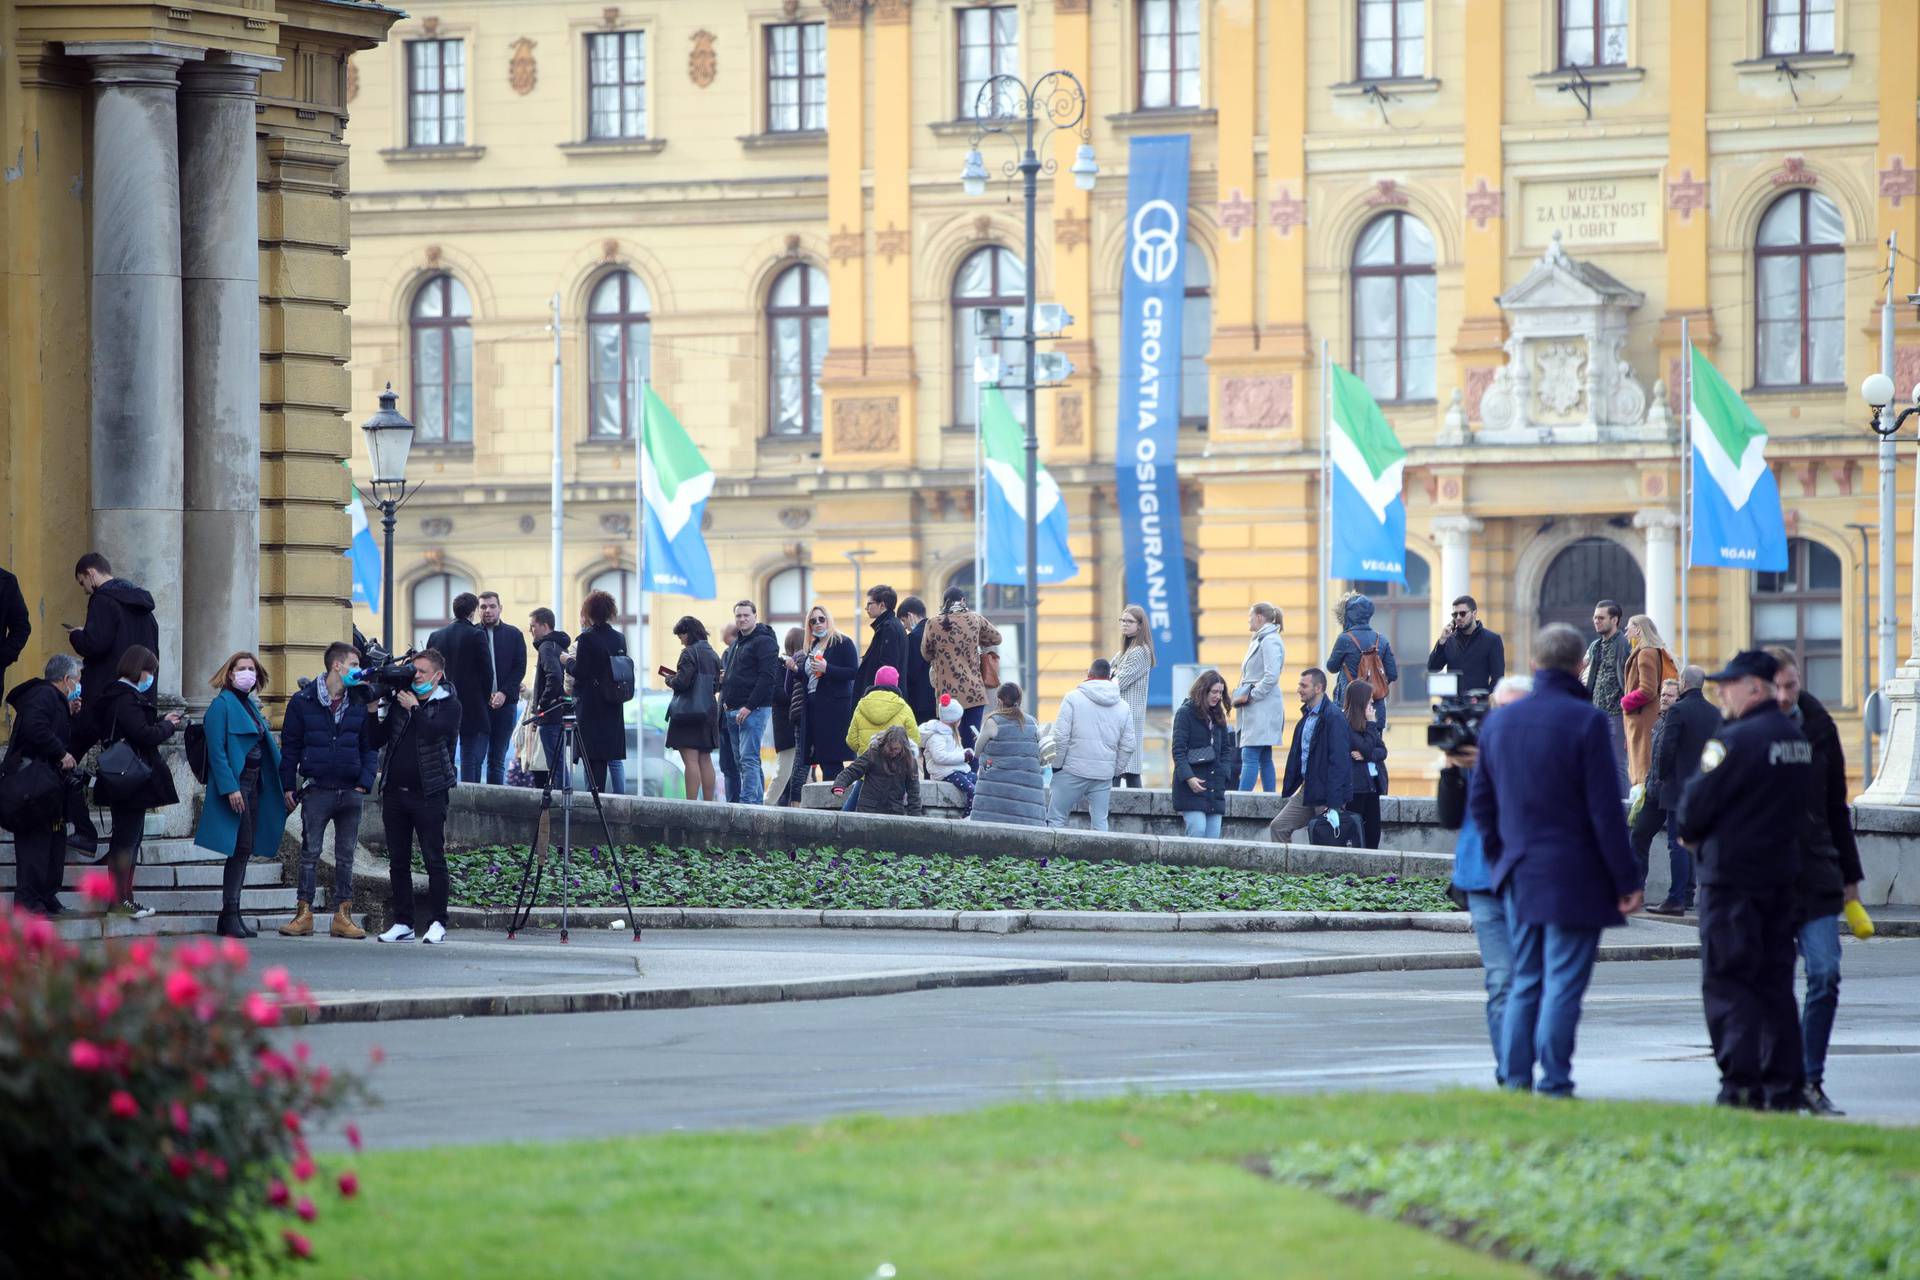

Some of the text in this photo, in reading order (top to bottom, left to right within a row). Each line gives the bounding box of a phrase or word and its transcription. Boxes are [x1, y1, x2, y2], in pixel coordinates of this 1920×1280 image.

[1568, 185, 1616, 202] MUZEJ
[1536, 202, 1647, 222] ZA UMJETNOST
[1579, 222, 1617, 238] OBRT
[1136, 296, 1169, 629] CROATIA OSIGURANJE
[1016, 564, 1054, 576] VAN
